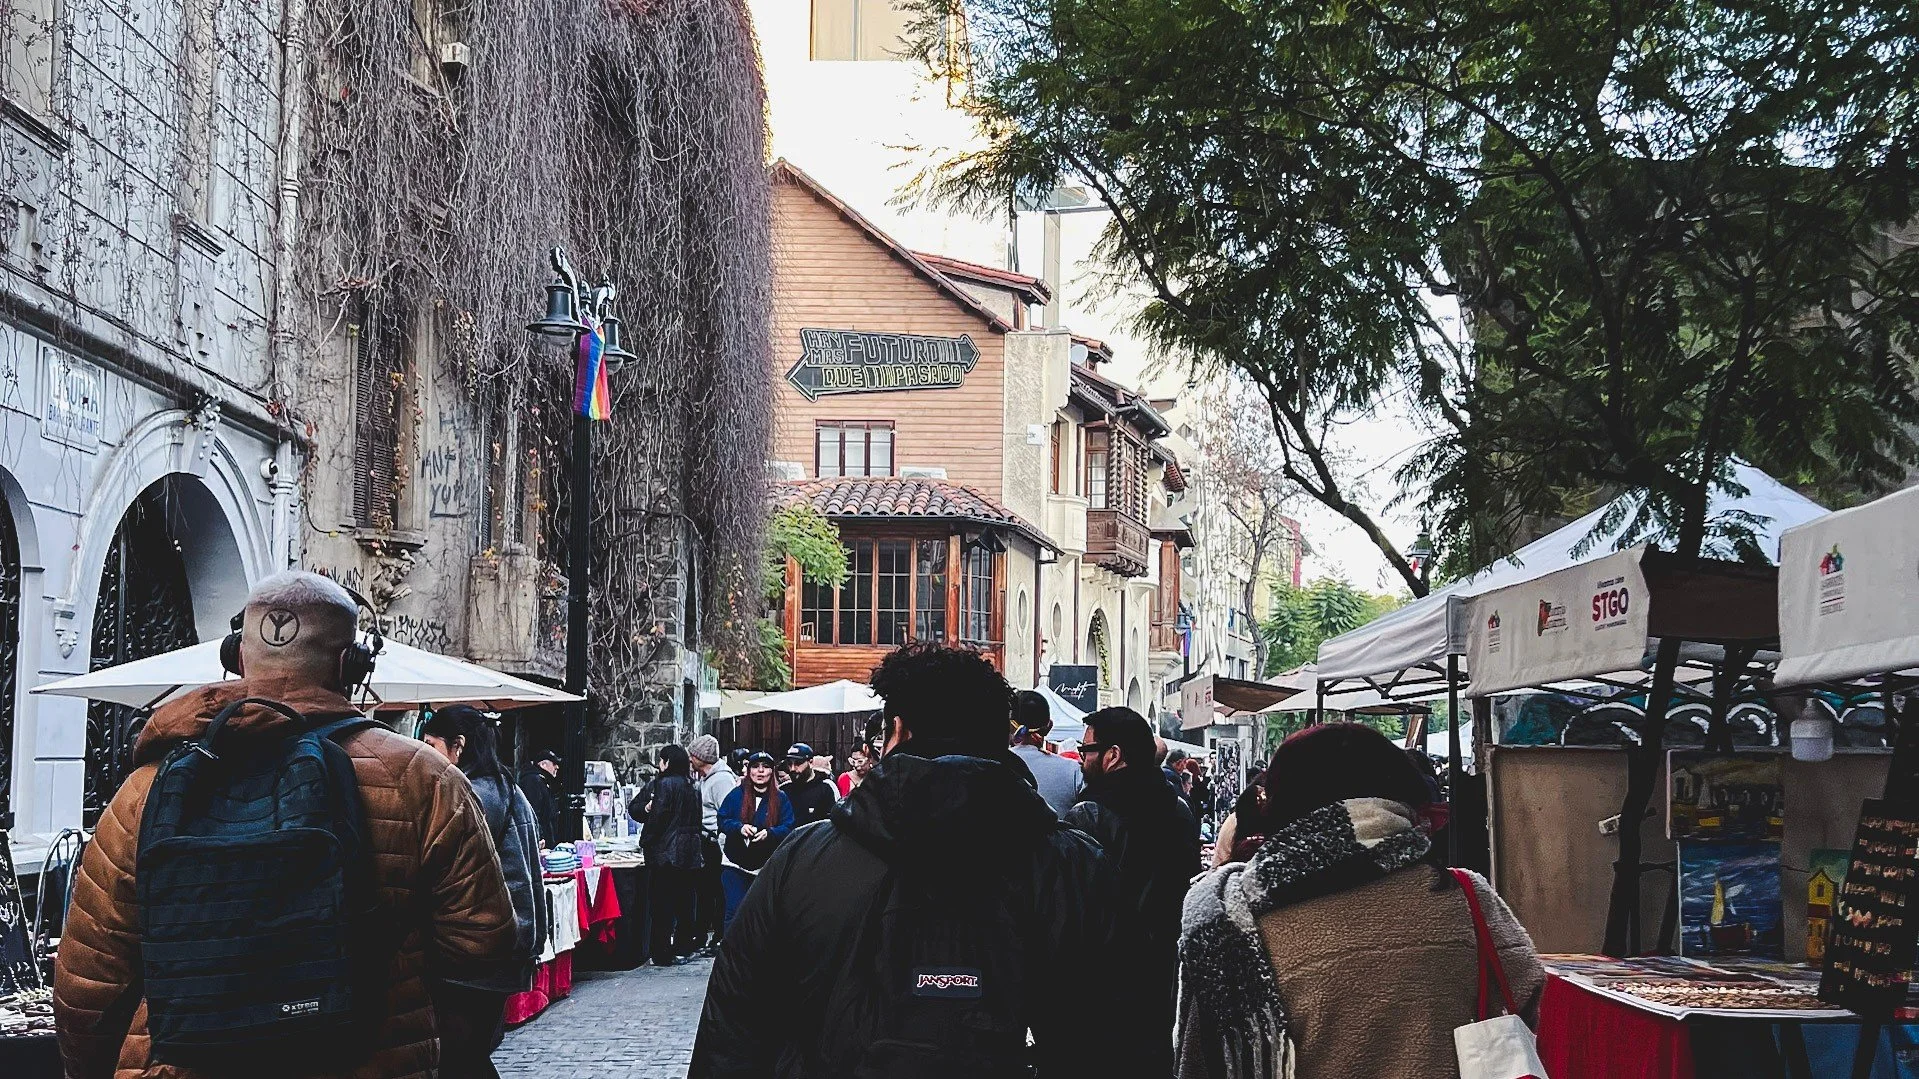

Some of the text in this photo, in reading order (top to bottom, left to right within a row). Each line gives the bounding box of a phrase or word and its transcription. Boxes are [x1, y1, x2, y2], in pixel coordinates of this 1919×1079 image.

[807, 331, 842, 348] HAY
[810, 347, 844, 364] MAS
[822, 365, 964, 388] QUE PASADO
[1592, 587, 1629, 621] STGO
[917, 975, 978, 988] JANSPORT
[291, 1001, 319, 1011] xtrem
